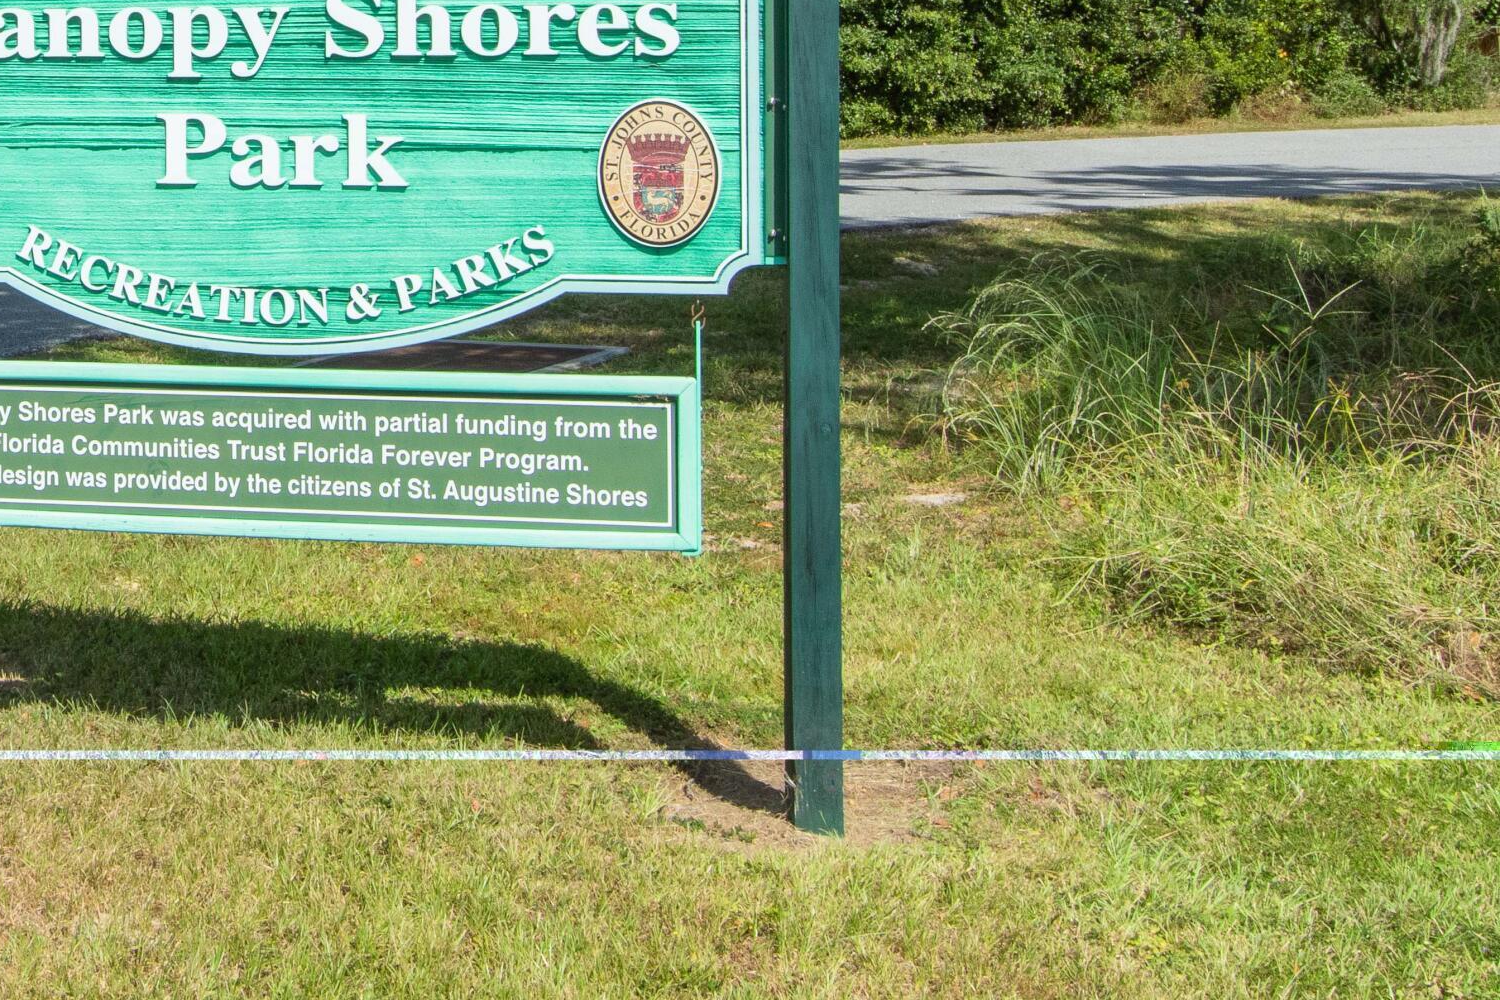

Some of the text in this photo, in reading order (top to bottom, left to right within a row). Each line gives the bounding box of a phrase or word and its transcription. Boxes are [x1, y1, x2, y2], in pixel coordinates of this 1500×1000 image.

[155, 113, 410, 190] Park
[611, 106, 664, 150] JOHNS
[672, 111, 713, 183] COUNTY
[619, 209, 701, 240] FLORIDA
[15, 223, 555, 326] RECREATION & PARKS
[18, 400, 97, 424] Shores
[103, 403, 154, 425] Park
[159, 409, 205, 427] was
[211, 409, 312, 434] acquired
[318, 409, 367, 432] with
[374, 412, 448, 437] partial
[454, 413, 547, 442] funding
[554, 415, 611, 439] from
[617, 418, 658, 441] the
[71, 434, 221, 460] Communities
[226, 439, 286, 462] Trust
[293, 441, 374, 465] Florida
[381, 444, 472, 468] Forever
[479, 447, 589, 475] Program.
[65, 471, 108, 488] was
[113, 469, 208, 494] provided
[214, 471, 241, 498] by
[246, 472, 282, 495] the
[287, 474, 372, 498] citizens
[378, 477, 401, 498] of
[407, 477, 437, 500] St.
[442, 479, 560, 507] Augustine
[566, 482, 648, 508] Shores
